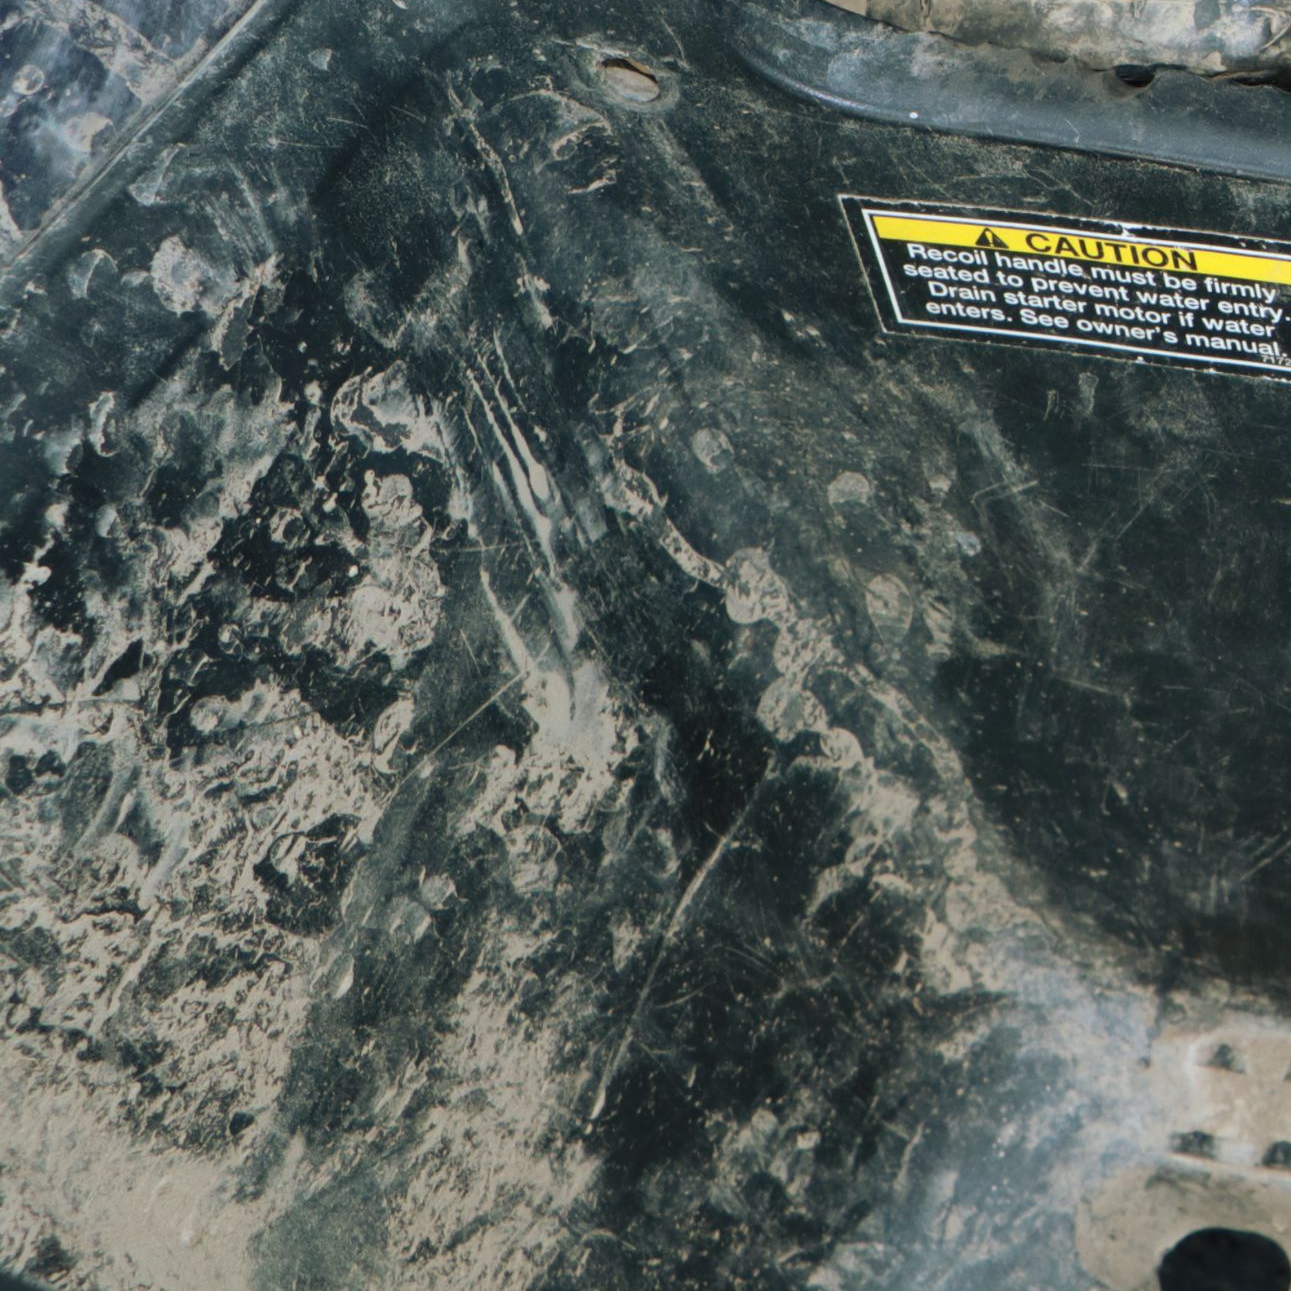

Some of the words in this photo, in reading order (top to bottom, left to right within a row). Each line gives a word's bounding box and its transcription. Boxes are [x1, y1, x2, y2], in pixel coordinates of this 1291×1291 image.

[907, 243, 988, 265] Recoil
[995, 251, 1084, 277] handle
[1090, 266, 1157, 287] must
[1163, 272, 1197, 290] be
[1204, 277, 1276, 304] firmly
[1025, 232, 1198, 270] CAUTION
[903, 262, 991, 283] seated
[997, 271, 1024, 287] to
[1031, 277, 1130, 302] prevent
[1136, 290, 1209, 310] water
[1218, 300, 1291, 323] entry.
[928, 280, 996, 302] Drain
[1004, 290, 1088, 313] starter
[1095, 303, 1171, 324] motor
[1178, 311, 1195, 328] if
[1201, 317, 1277, 337] water
[926, 302, 1013, 322] enters.
[1020, 308, 1069, 329] See
[1076, 319, 1178, 343] owner's
[1185, 333, 1287, 357] manual.
